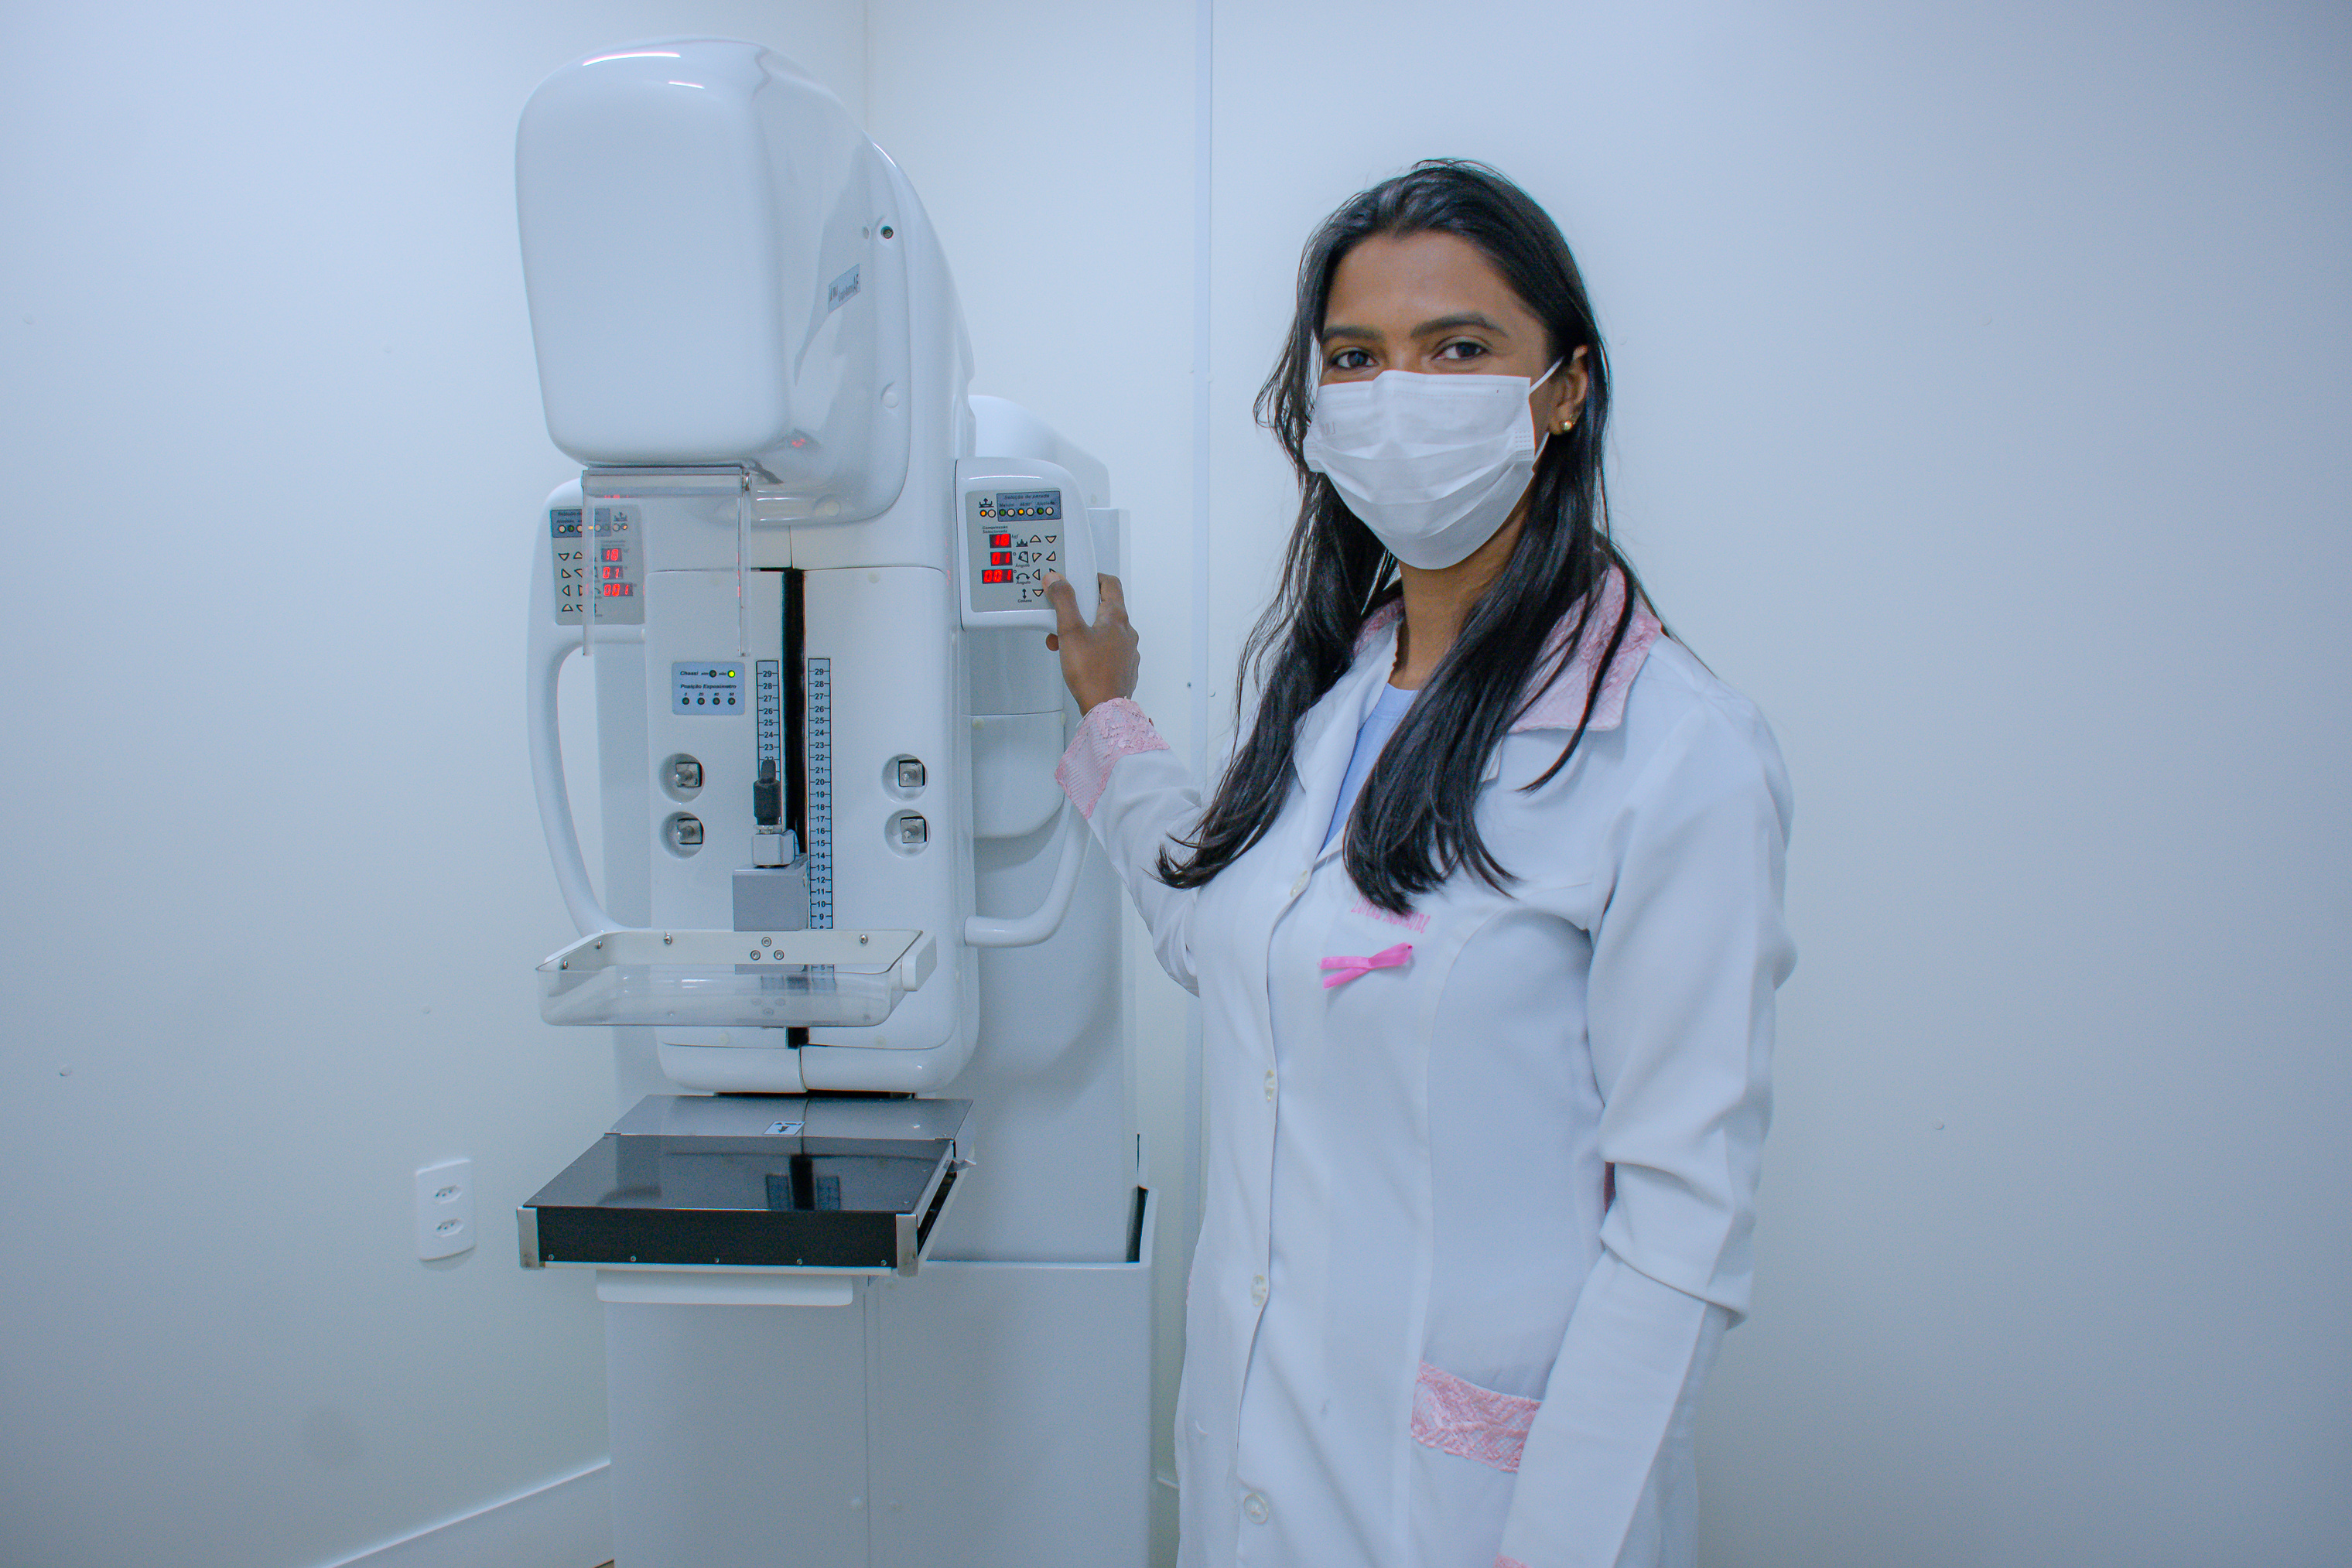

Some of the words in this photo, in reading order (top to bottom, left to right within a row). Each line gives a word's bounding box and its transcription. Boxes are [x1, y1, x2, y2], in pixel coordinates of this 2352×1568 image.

[607, 548, 619, 561] 18
[992, 552, 1010, 565] 01
[603, 566, 619, 579] 01
[984, 569, 1012, 582] 001
[603, 583, 628, 597] 001
